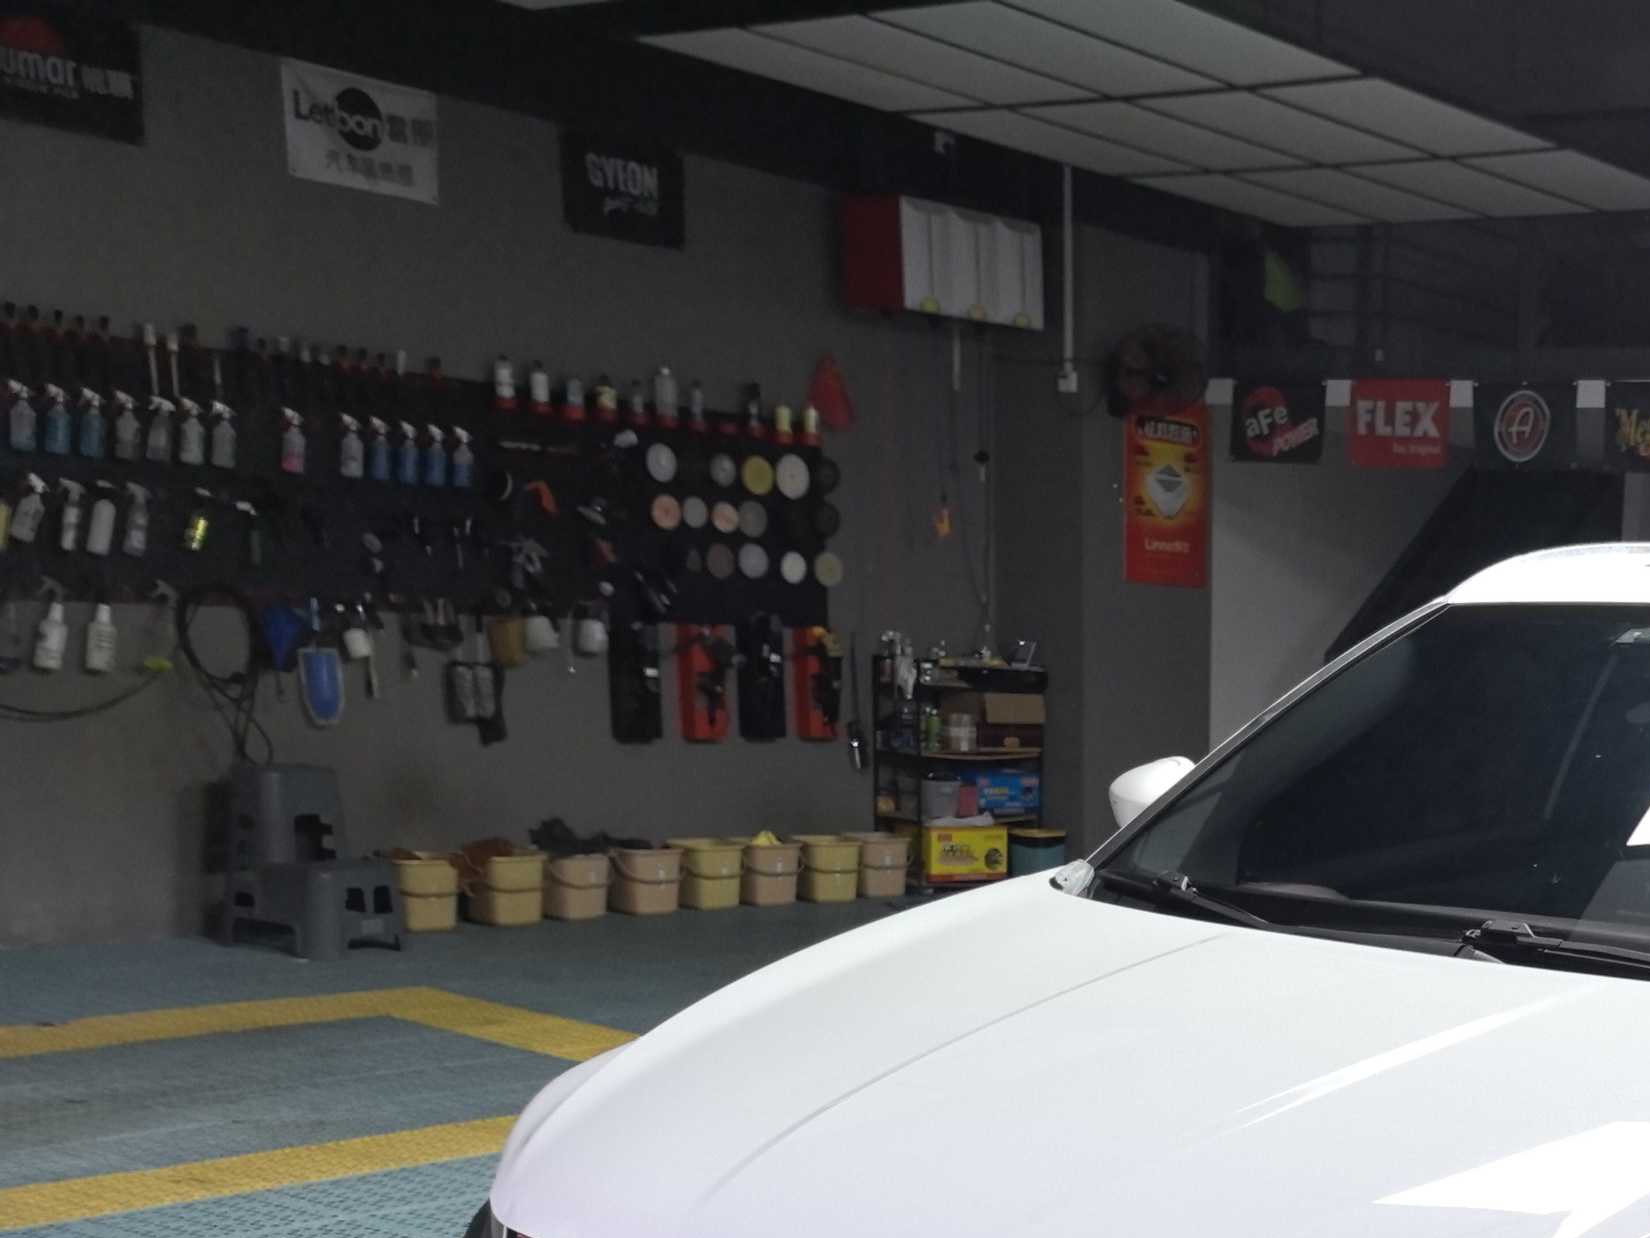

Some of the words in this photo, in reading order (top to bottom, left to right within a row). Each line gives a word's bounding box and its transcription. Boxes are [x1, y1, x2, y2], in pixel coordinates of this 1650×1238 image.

[293, 90, 384, 142] Letbon
[584, 153, 659, 200] GYEON
[1243, 405, 1289, 438] aFe
[1355, 400, 1441, 438] FLEX
